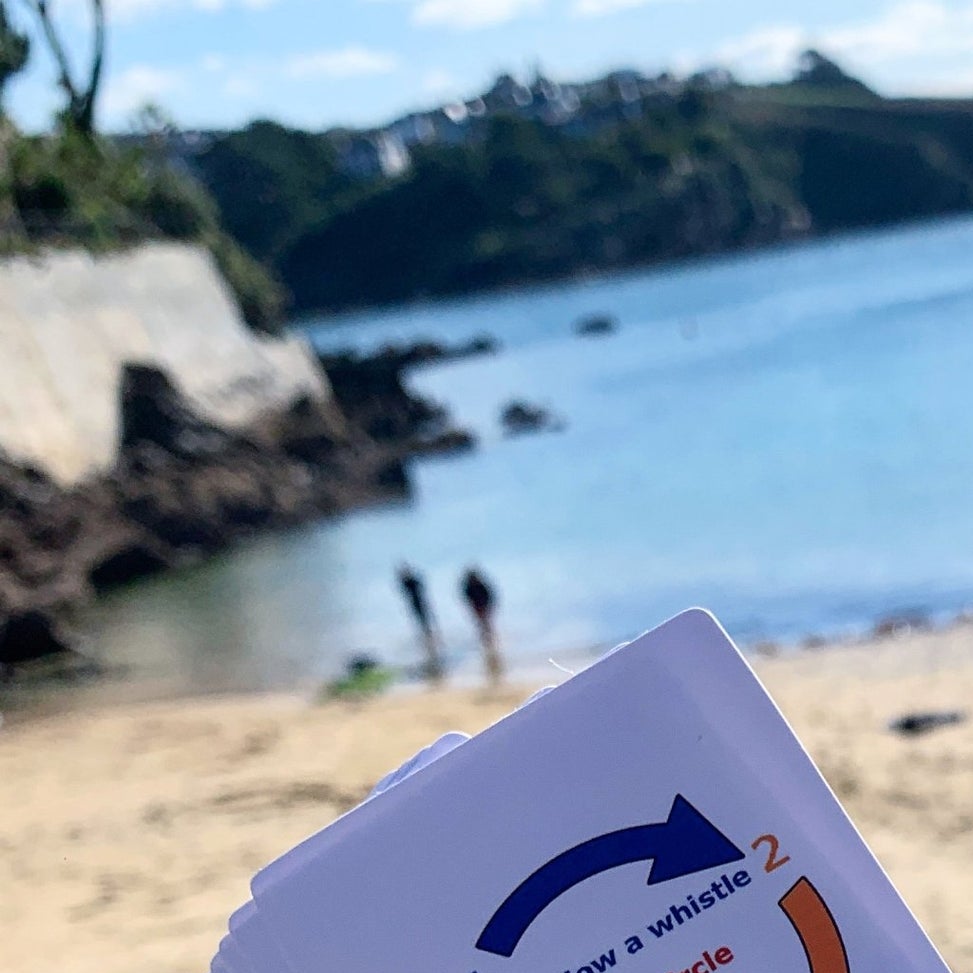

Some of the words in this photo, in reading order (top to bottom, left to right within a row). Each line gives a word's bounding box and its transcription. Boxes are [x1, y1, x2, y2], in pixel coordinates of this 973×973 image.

[751, 834, 790, 873] 2
[624, 934, 644, 954] a
[647, 868, 752, 938] whistle
